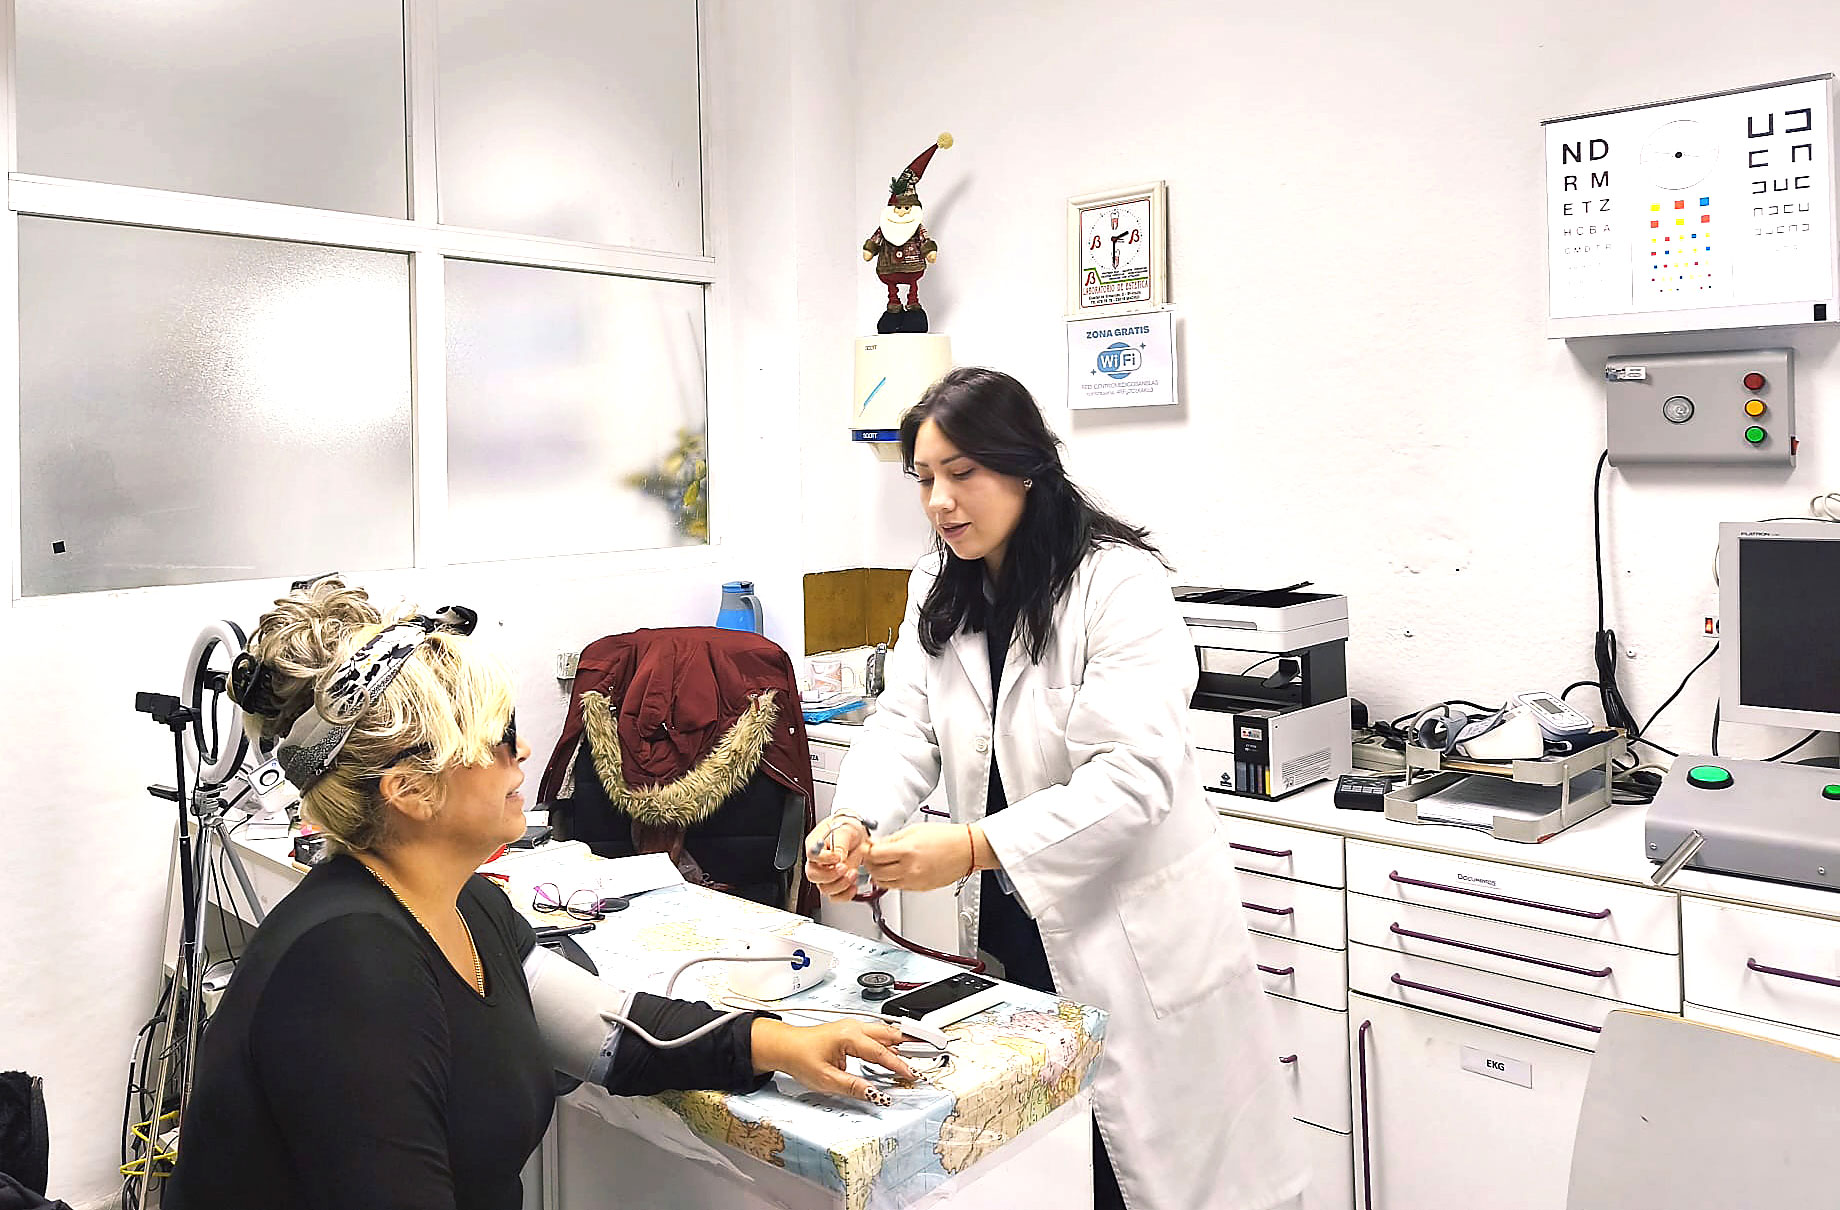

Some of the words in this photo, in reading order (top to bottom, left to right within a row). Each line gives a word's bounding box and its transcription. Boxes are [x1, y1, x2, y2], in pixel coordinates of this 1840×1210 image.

[1086, 330, 1113, 339] ZONA
[1114, 325, 1150, 337] GRATIS
[1486, 1059, 1505, 1072] EKG
